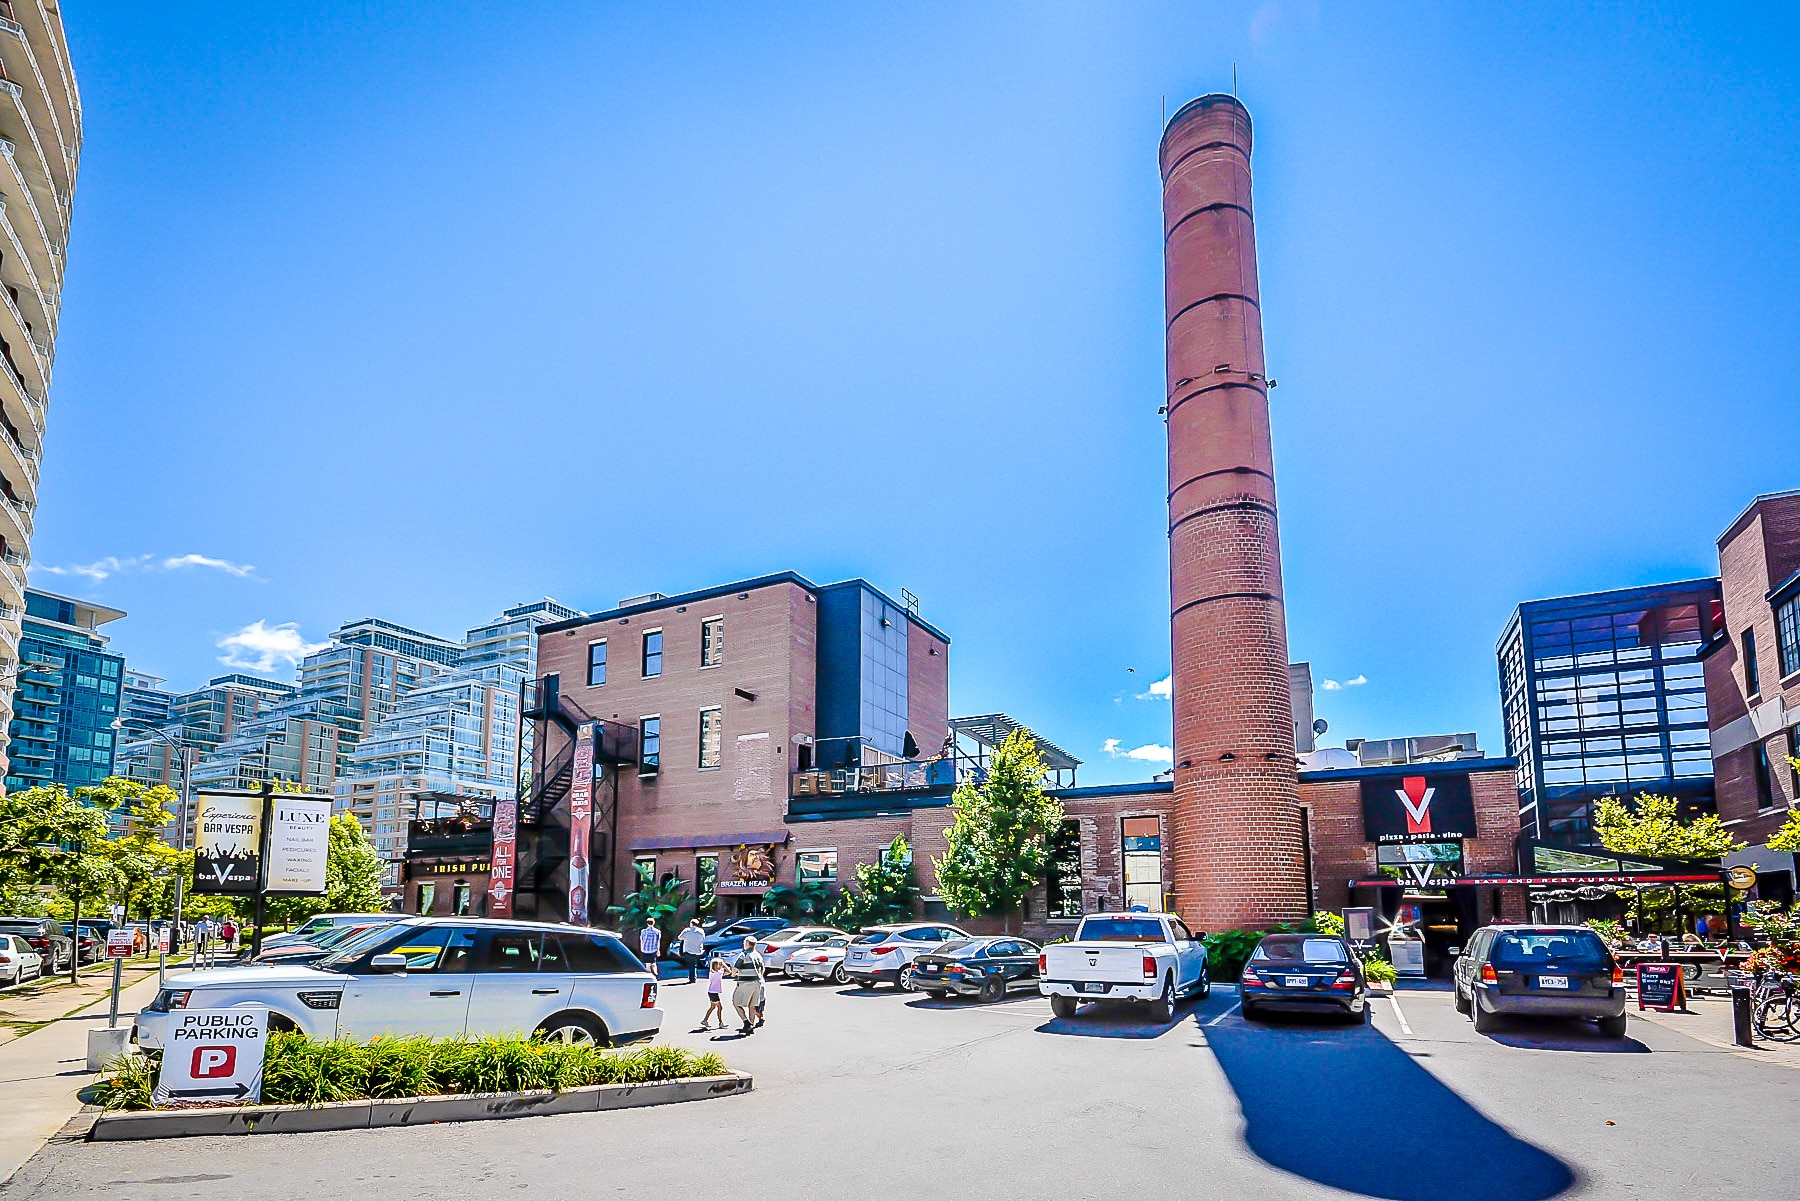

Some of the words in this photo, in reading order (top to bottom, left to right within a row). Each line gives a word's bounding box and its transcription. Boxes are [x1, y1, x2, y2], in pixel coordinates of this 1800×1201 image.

[202, 806, 257, 823] Experience
[279, 810, 326, 824] LUXE
[203, 822, 223, 834] BAR
[225, 823, 254, 835] VESPA
[1379, 834, 1404, 842] pizza
[1410, 831, 1436, 841] pasta
[1442, 831, 1463, 839] vino
[494, 846, 512, 859] ALL
[433, 863, 466, 873] IRISH
[491, 865, 513, 879] ONE
[198, 872, 217, 880] bar
[1396, 877, 1417, 886] bar
[720, 880, 747, 888] BRAZEN
[183, 1014, 254, 1028] PUBLIC
[174, 1027, 259, 1041] PARKING
[198, 1049, 228, 1075] P
